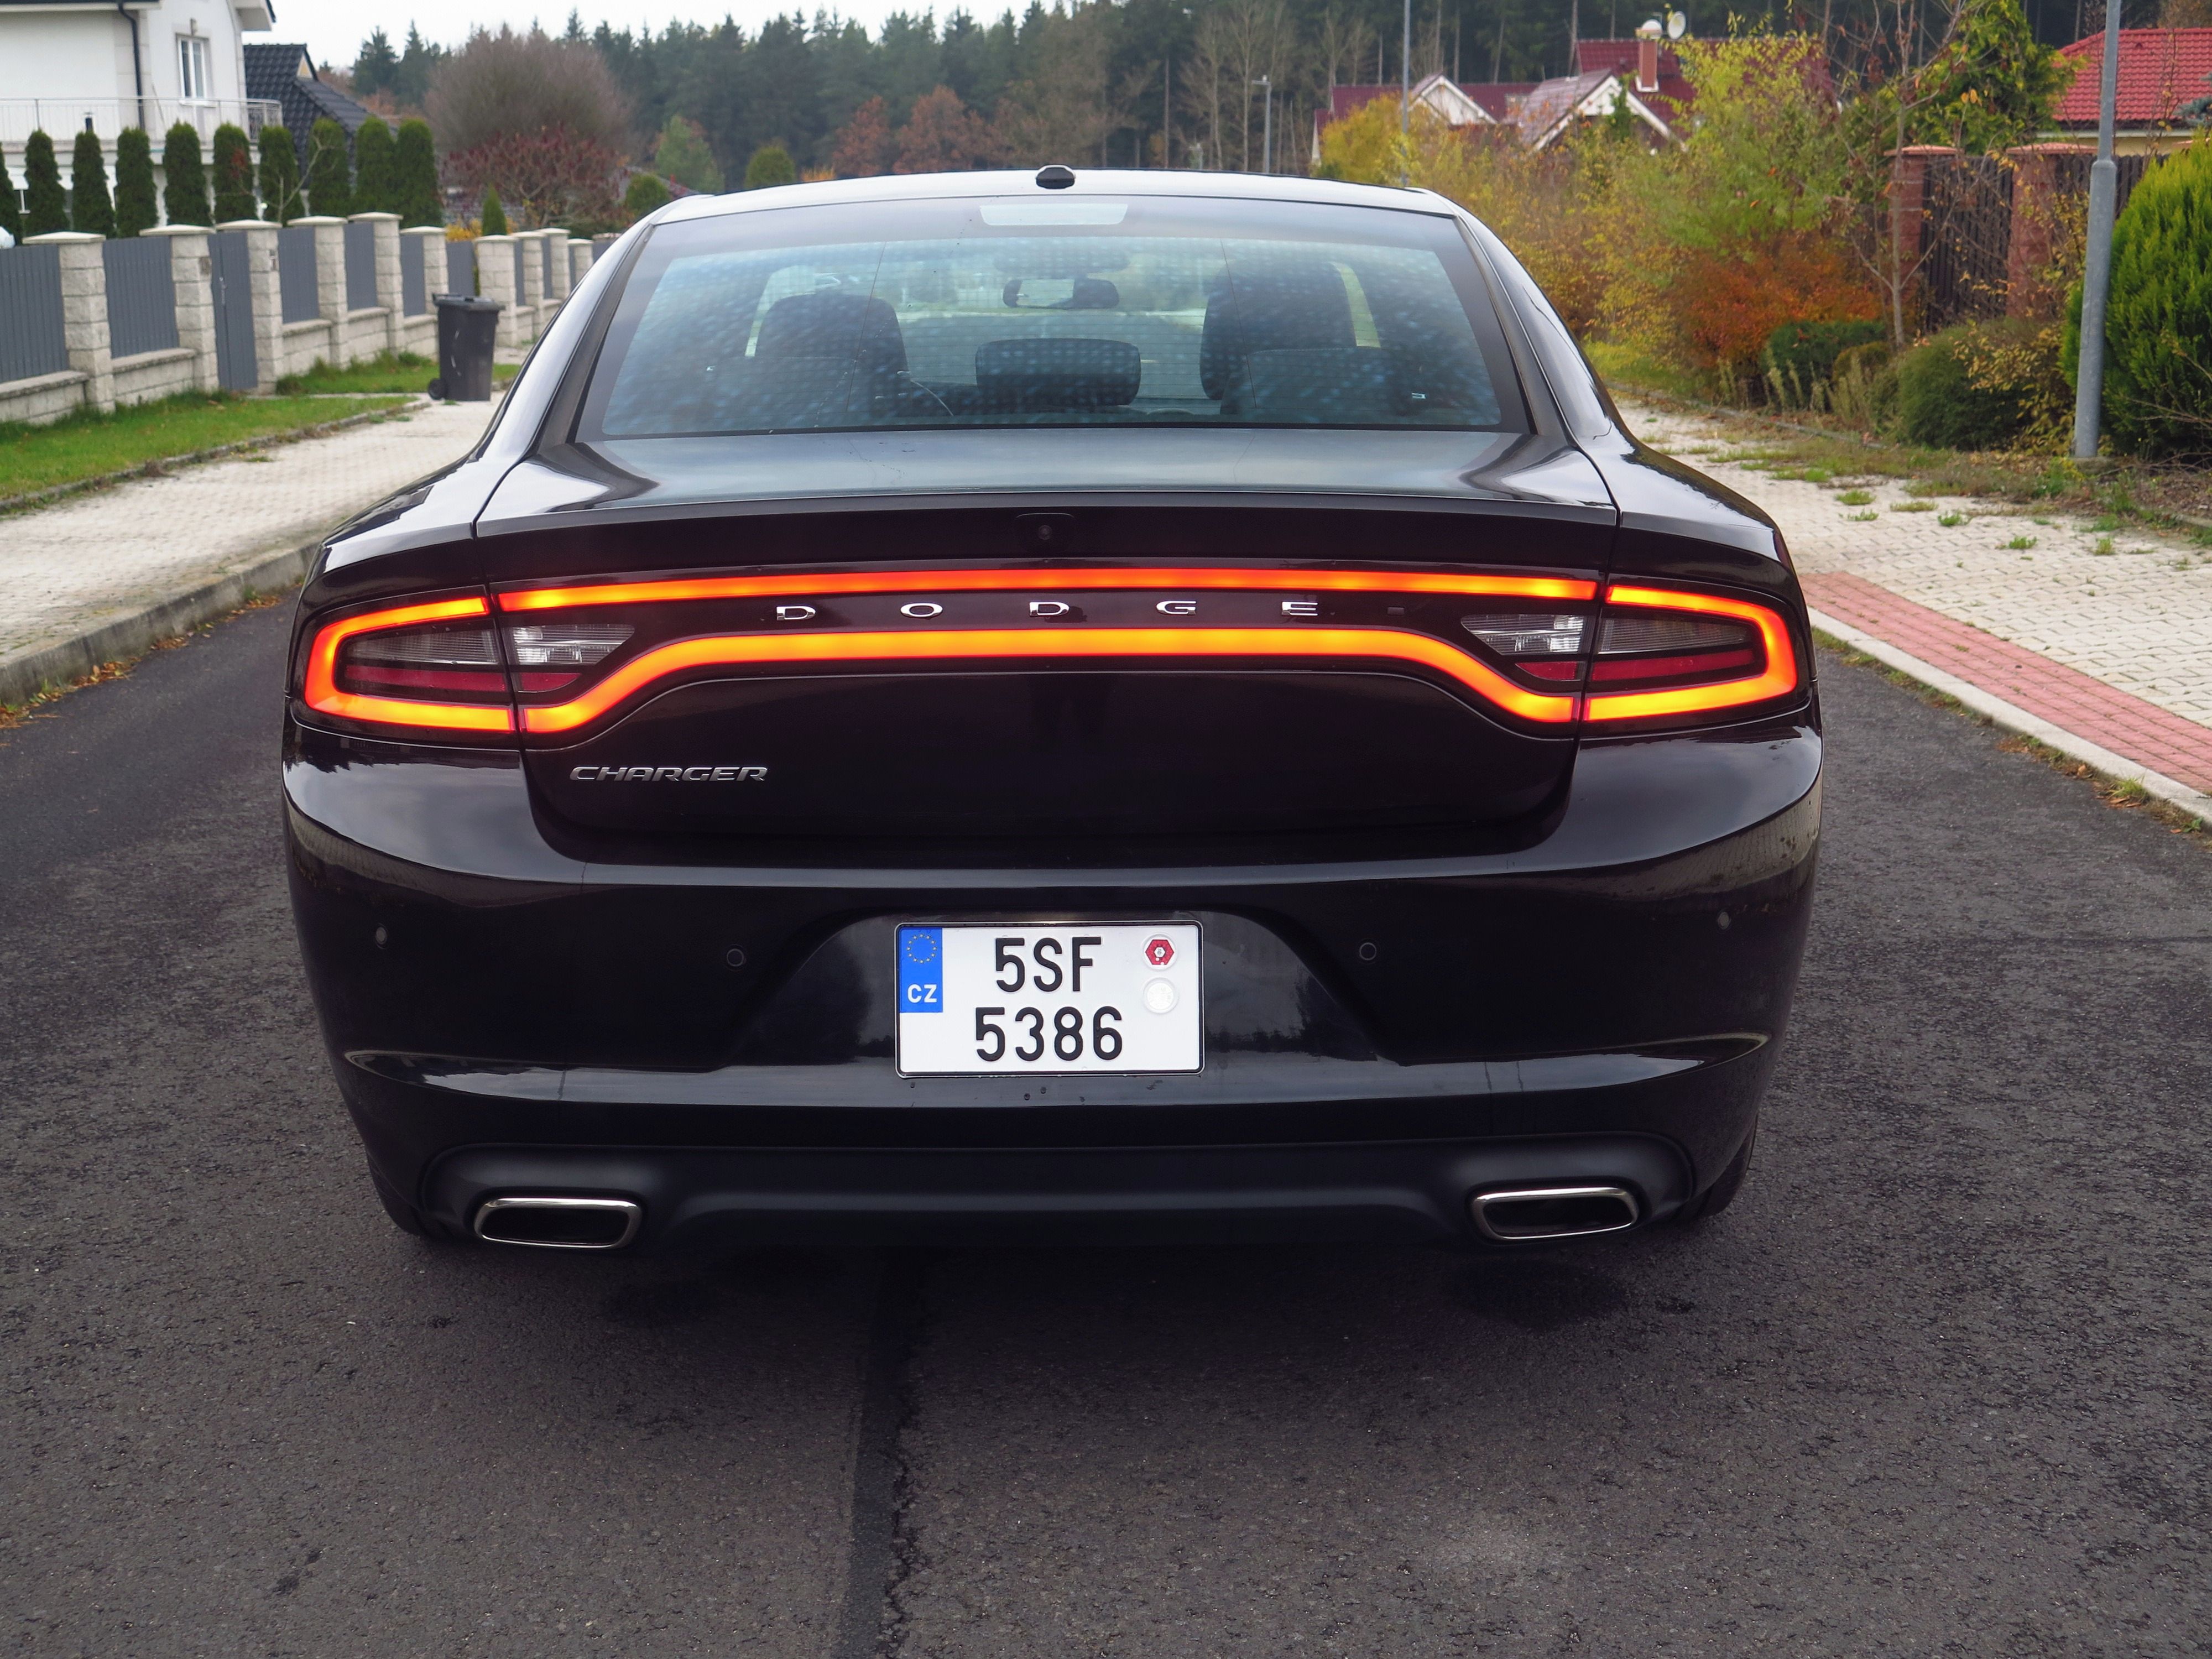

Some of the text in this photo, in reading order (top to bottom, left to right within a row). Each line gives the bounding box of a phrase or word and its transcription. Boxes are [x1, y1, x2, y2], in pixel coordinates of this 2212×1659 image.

[776, 601, 1318, 620] DODGE
[569, 766, 768, 781] CHARGER
[995, 936, 1102, 993] 5SF
[907, 984, 937, 1004] CZ
[975, 1006, 1123, 1062] 5386
